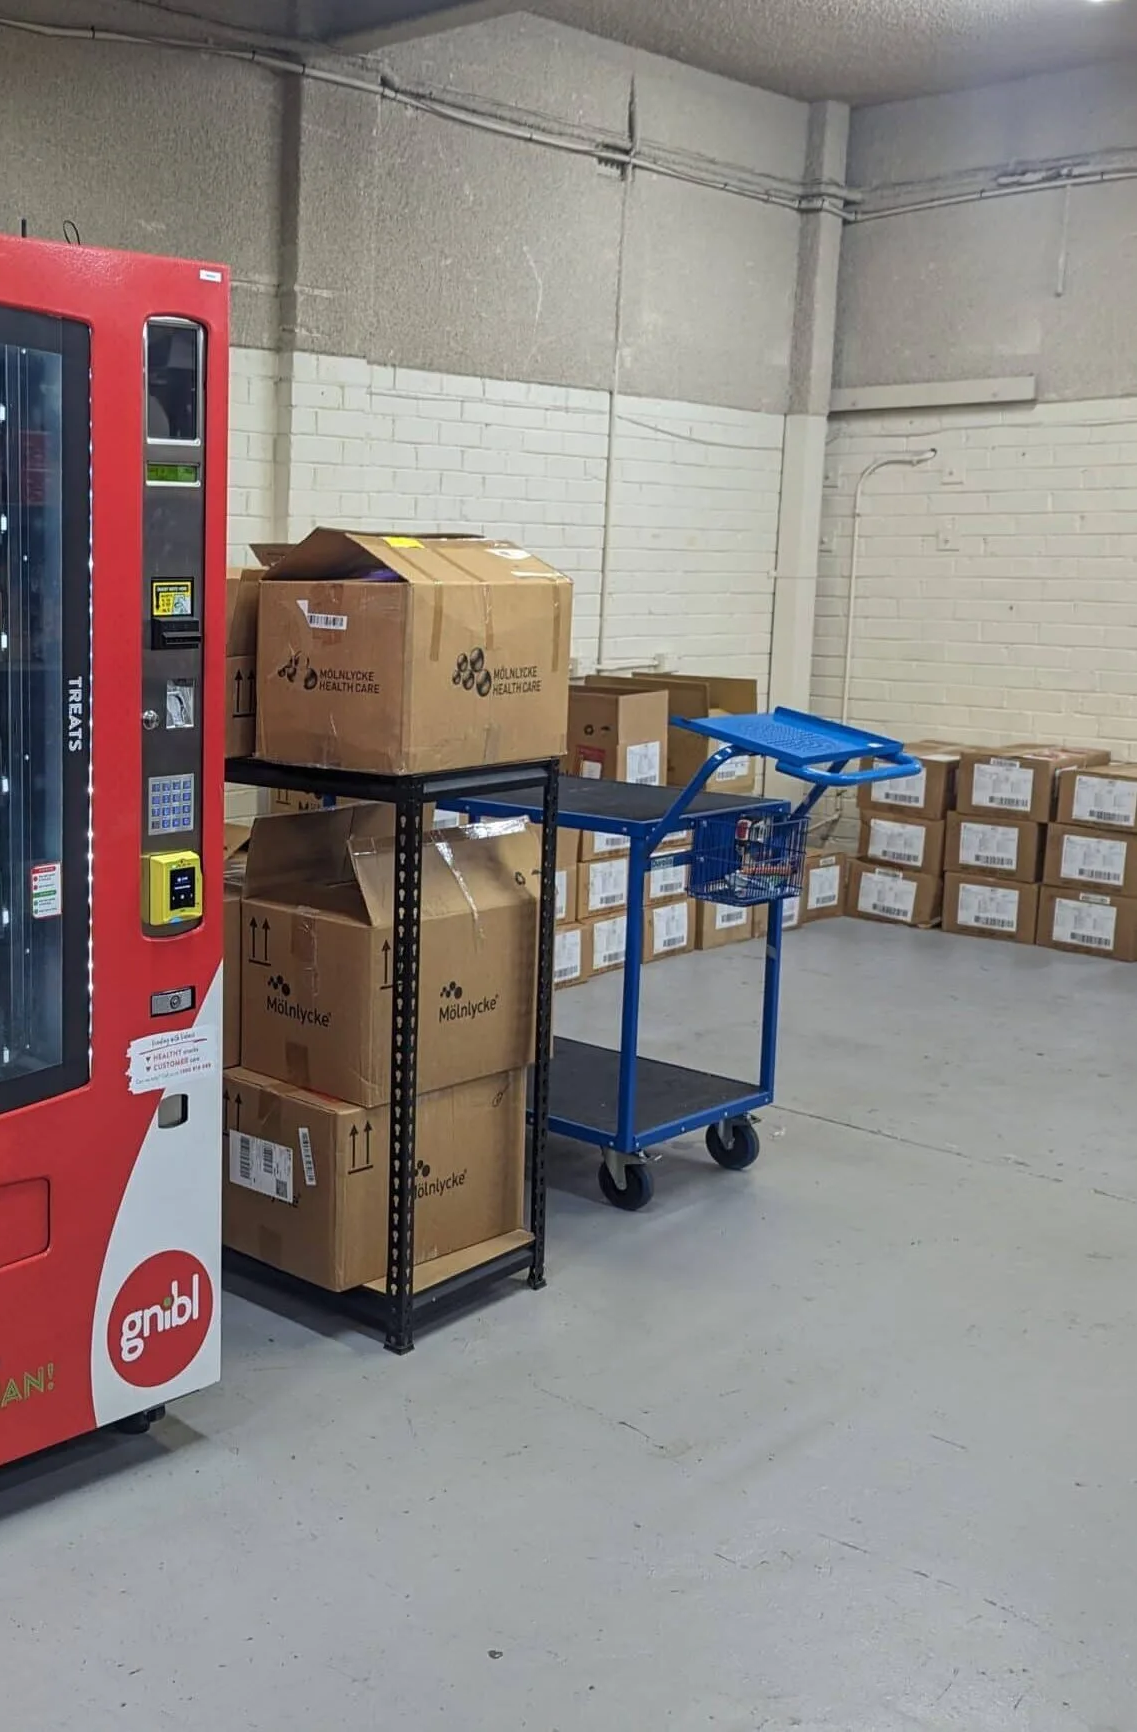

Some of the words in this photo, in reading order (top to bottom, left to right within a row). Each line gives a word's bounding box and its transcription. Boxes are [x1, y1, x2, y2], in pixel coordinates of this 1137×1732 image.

[319, 681, 353, 692] HEALTH
[355, 683, 379, 694] CARE
[493, 682, 521, 695] HEALTH
[522, 680, 542, 693] CARE
[68, 676, 83, 752] TREATS
[153, 1049, 182, 1062] HEALTHY
[153, 1057, 188, 1071] CUSTOMER
[121, 1273, 200, 1363] gnibl
